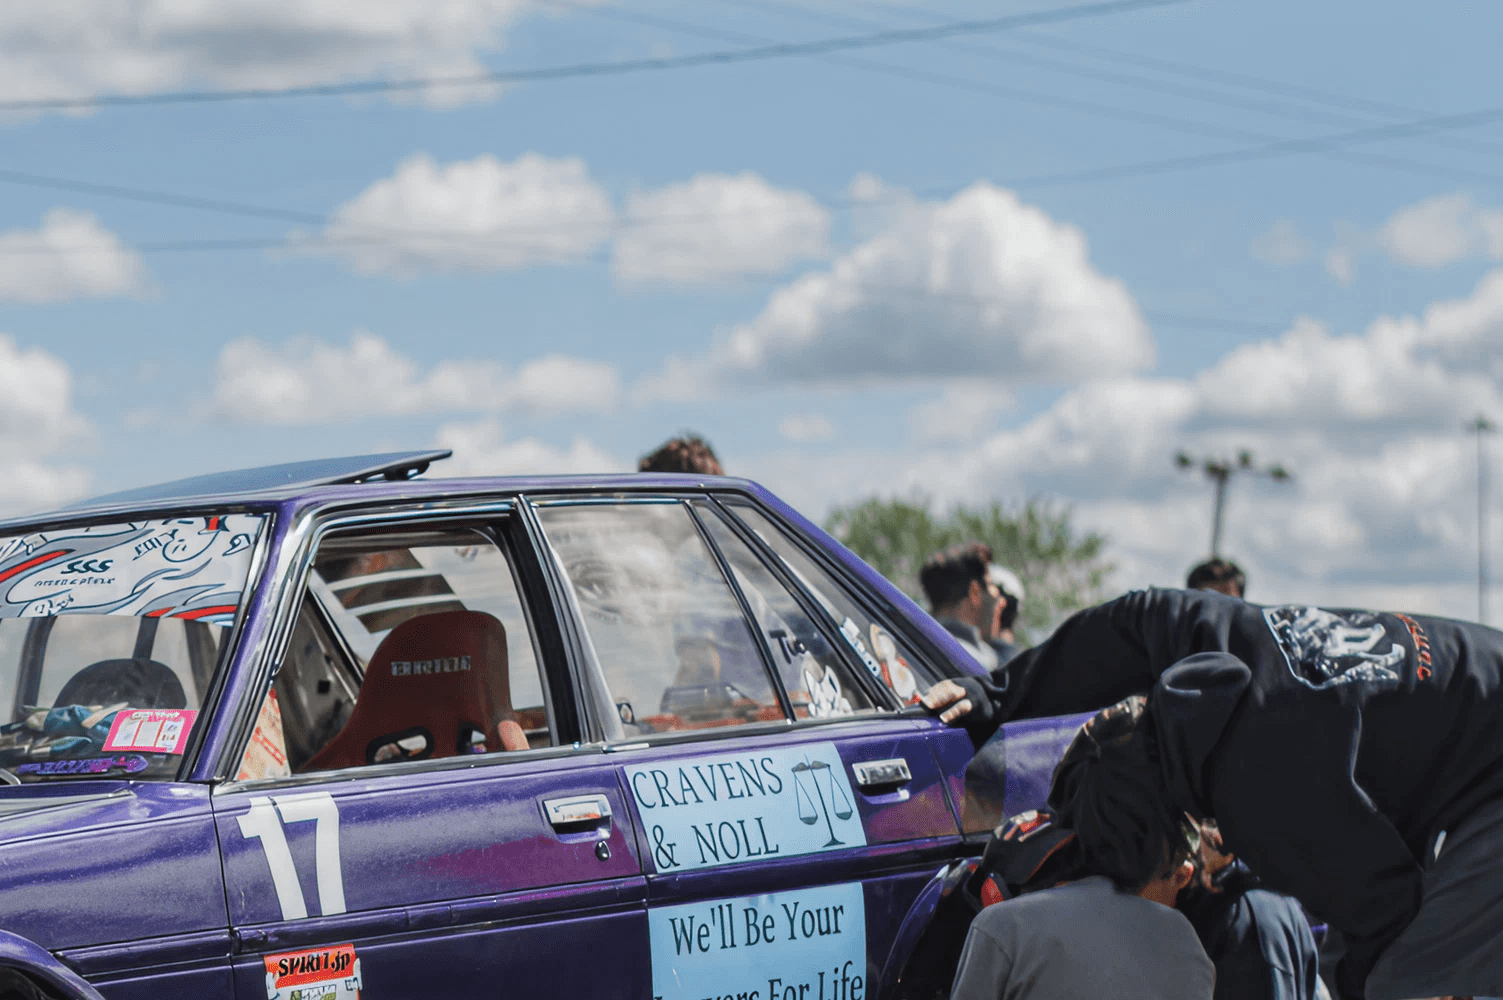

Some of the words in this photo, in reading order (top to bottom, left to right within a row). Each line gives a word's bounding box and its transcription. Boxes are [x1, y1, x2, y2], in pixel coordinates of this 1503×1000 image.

[632, 757, 783, 808] CRAVENS
[236, 791, 347, 921] 17
[652, 825, 680, 869] &
[691, 817, 779, 864] NOLL
[669, 903, 737, 956] We'll
[743, 907, 775, 946] Be
[781, 901, 844, 940] Your
